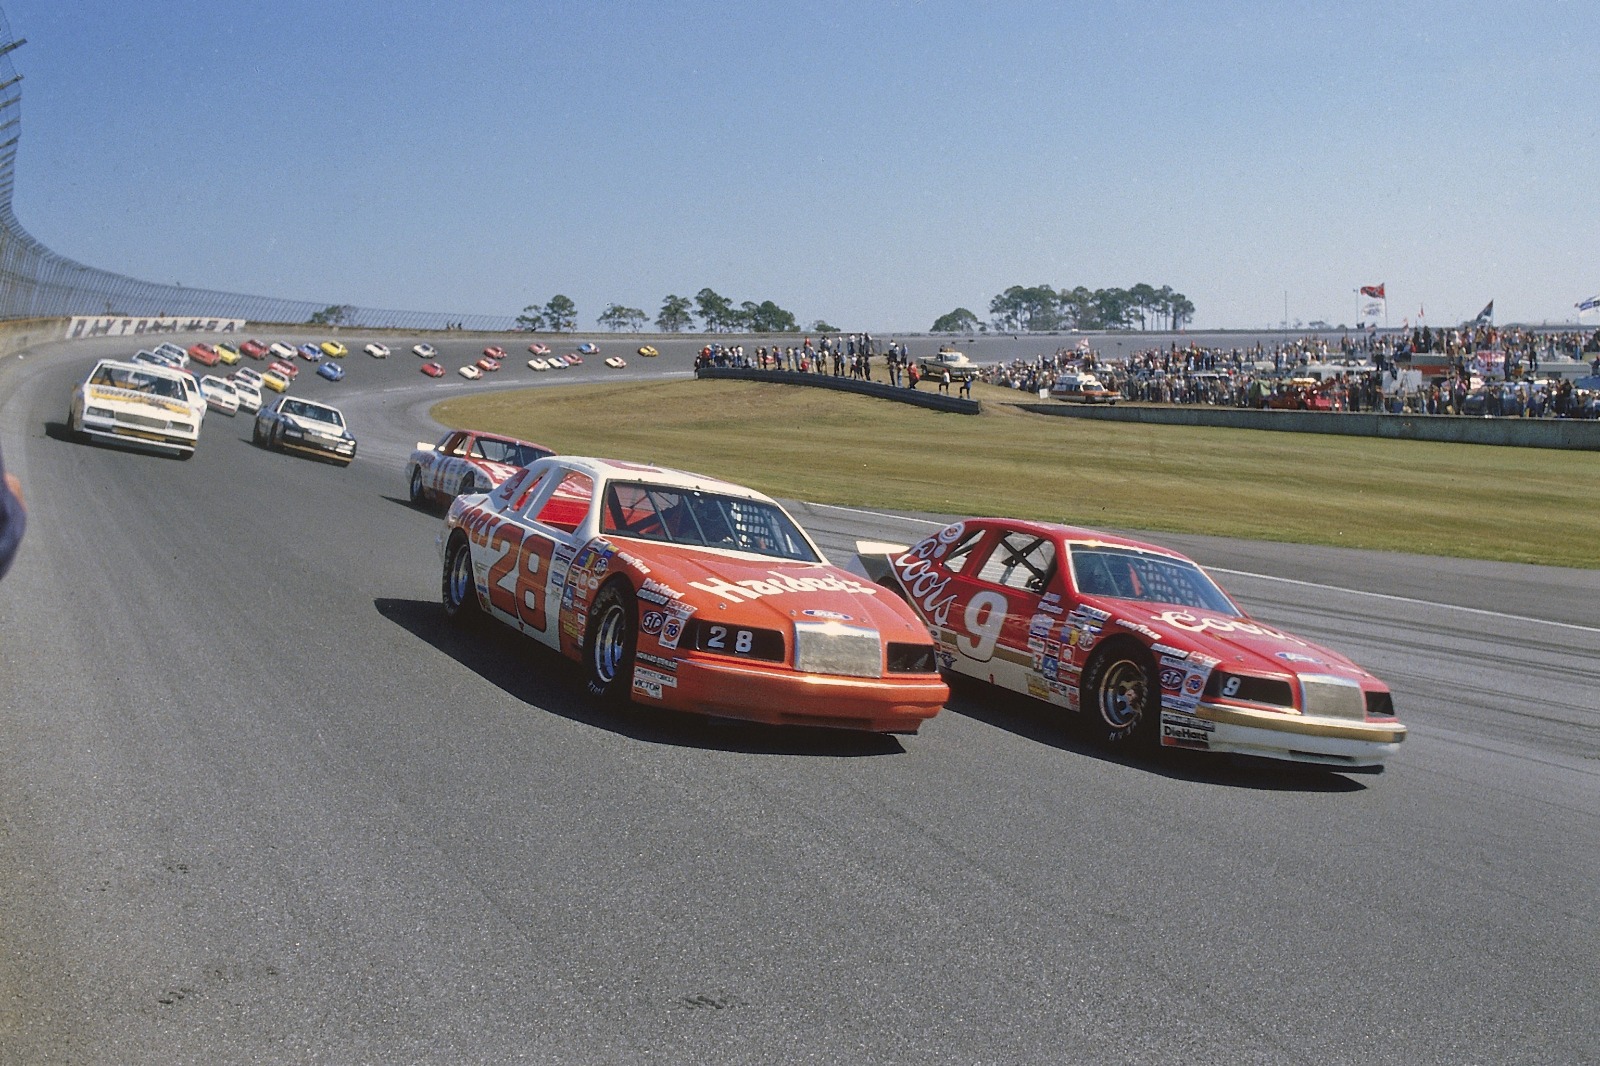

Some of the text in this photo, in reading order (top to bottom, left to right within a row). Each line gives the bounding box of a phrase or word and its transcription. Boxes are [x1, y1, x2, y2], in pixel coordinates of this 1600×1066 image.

[71, 318, 235, 338] DAYTONA USA
[487, 522, 556, 633] 28
[895, 538, 958, 626] Coors
[641, 577, 686, 600] DieHard
[687, 571, 877, 603] Hardee's
[667, 599, 696, 612] SPEED
[644, 613, 662, 629] STP
[665, 622, 679, 638] 76
[957, 590, 1009, 662] 9
[635, 679, 661, 690] VICTOR
[1160, 671, 1182, 685] STP
[1185, 679, 1203, 690] 76
[1222, 676, 1242, 696] 9
[1164, 726, 1209, 741] DieHard
